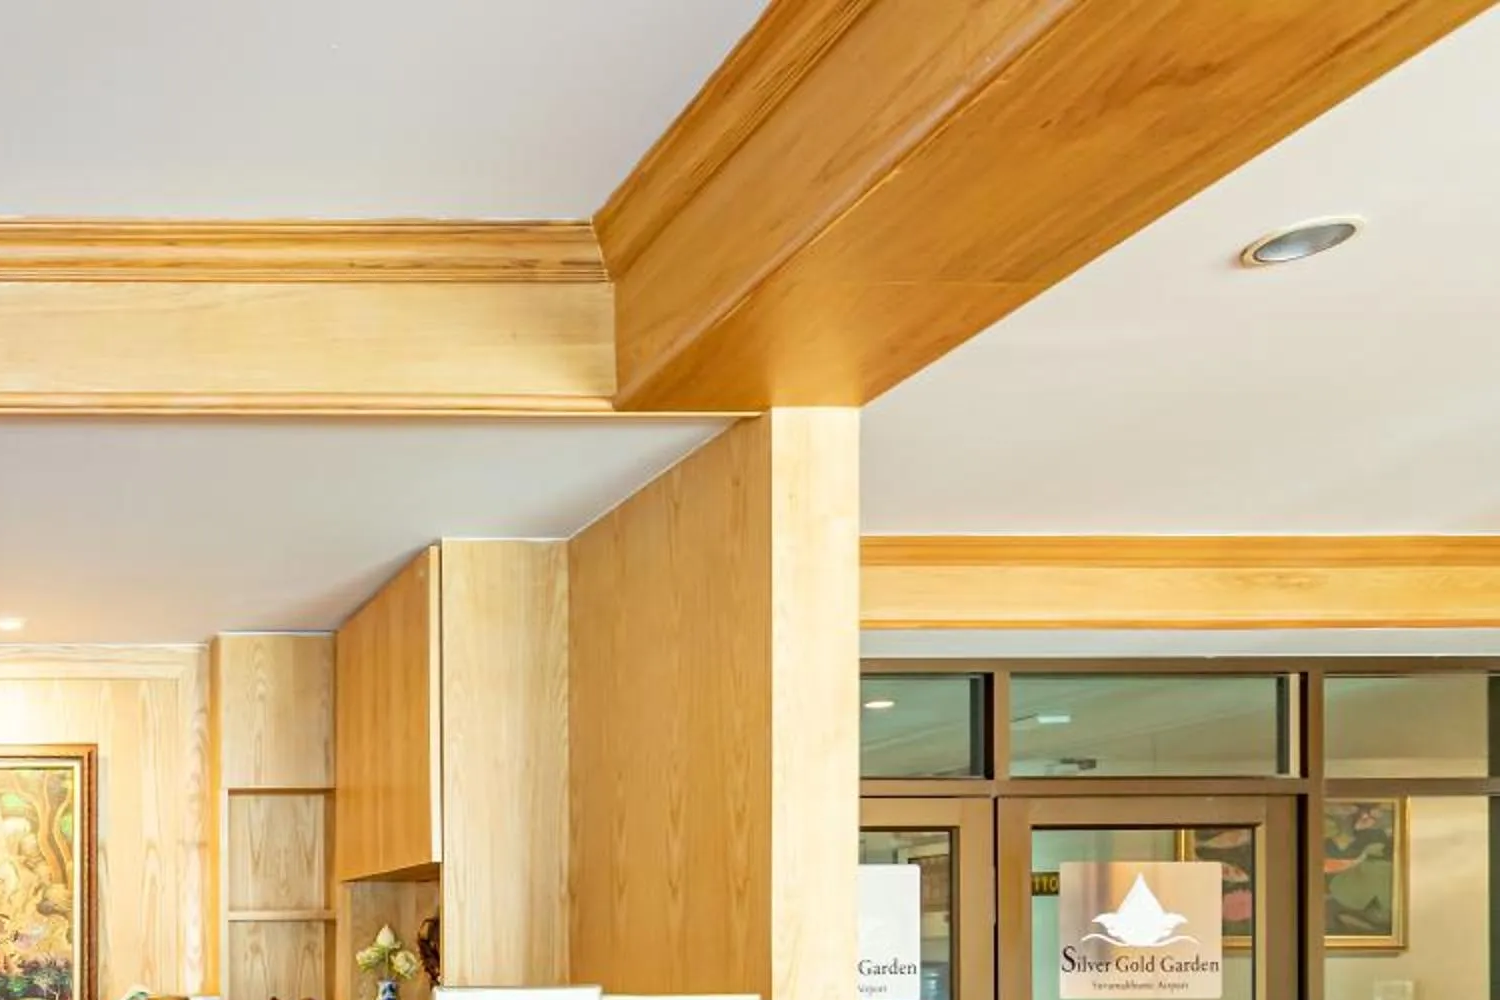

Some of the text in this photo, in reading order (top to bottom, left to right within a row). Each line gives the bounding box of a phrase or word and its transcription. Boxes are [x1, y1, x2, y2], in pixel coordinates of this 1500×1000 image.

[858, 957, 917, 976] Garden
[1062, 946, 1219, 973] Silver Gold Garden
